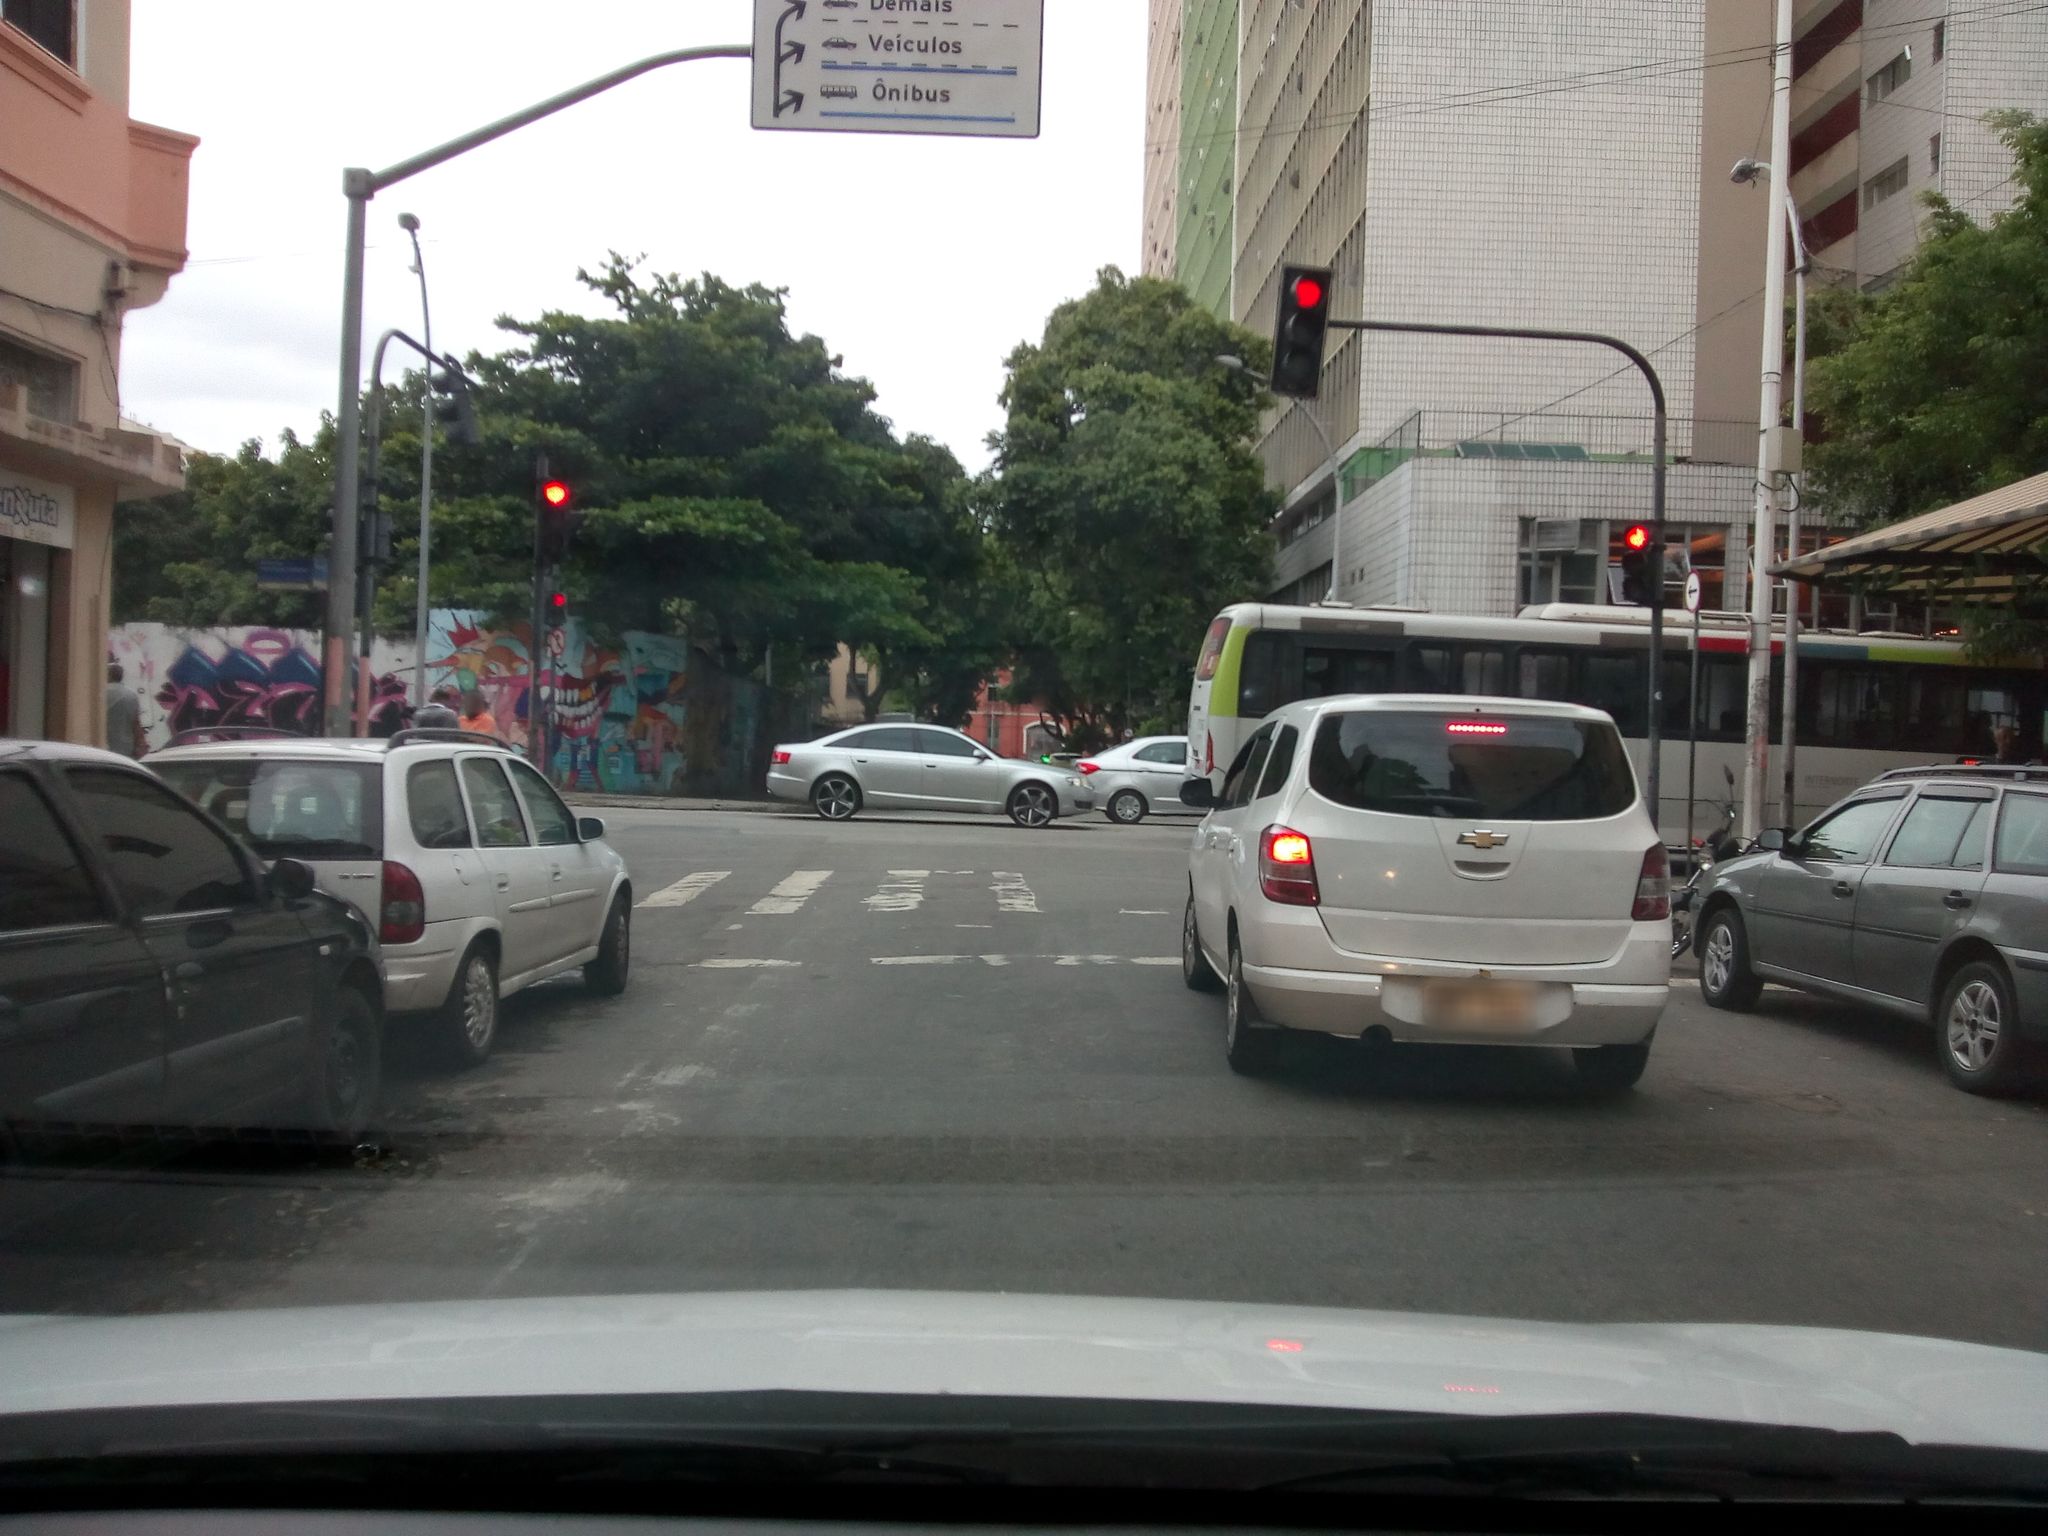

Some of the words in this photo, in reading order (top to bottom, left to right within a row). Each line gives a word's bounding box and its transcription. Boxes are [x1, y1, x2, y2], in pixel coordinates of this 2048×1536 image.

[870, 0, 952, 12] Demais
[869, 34, 962, 54] Veículos
[872, 78, 950, 102] Ônibus
